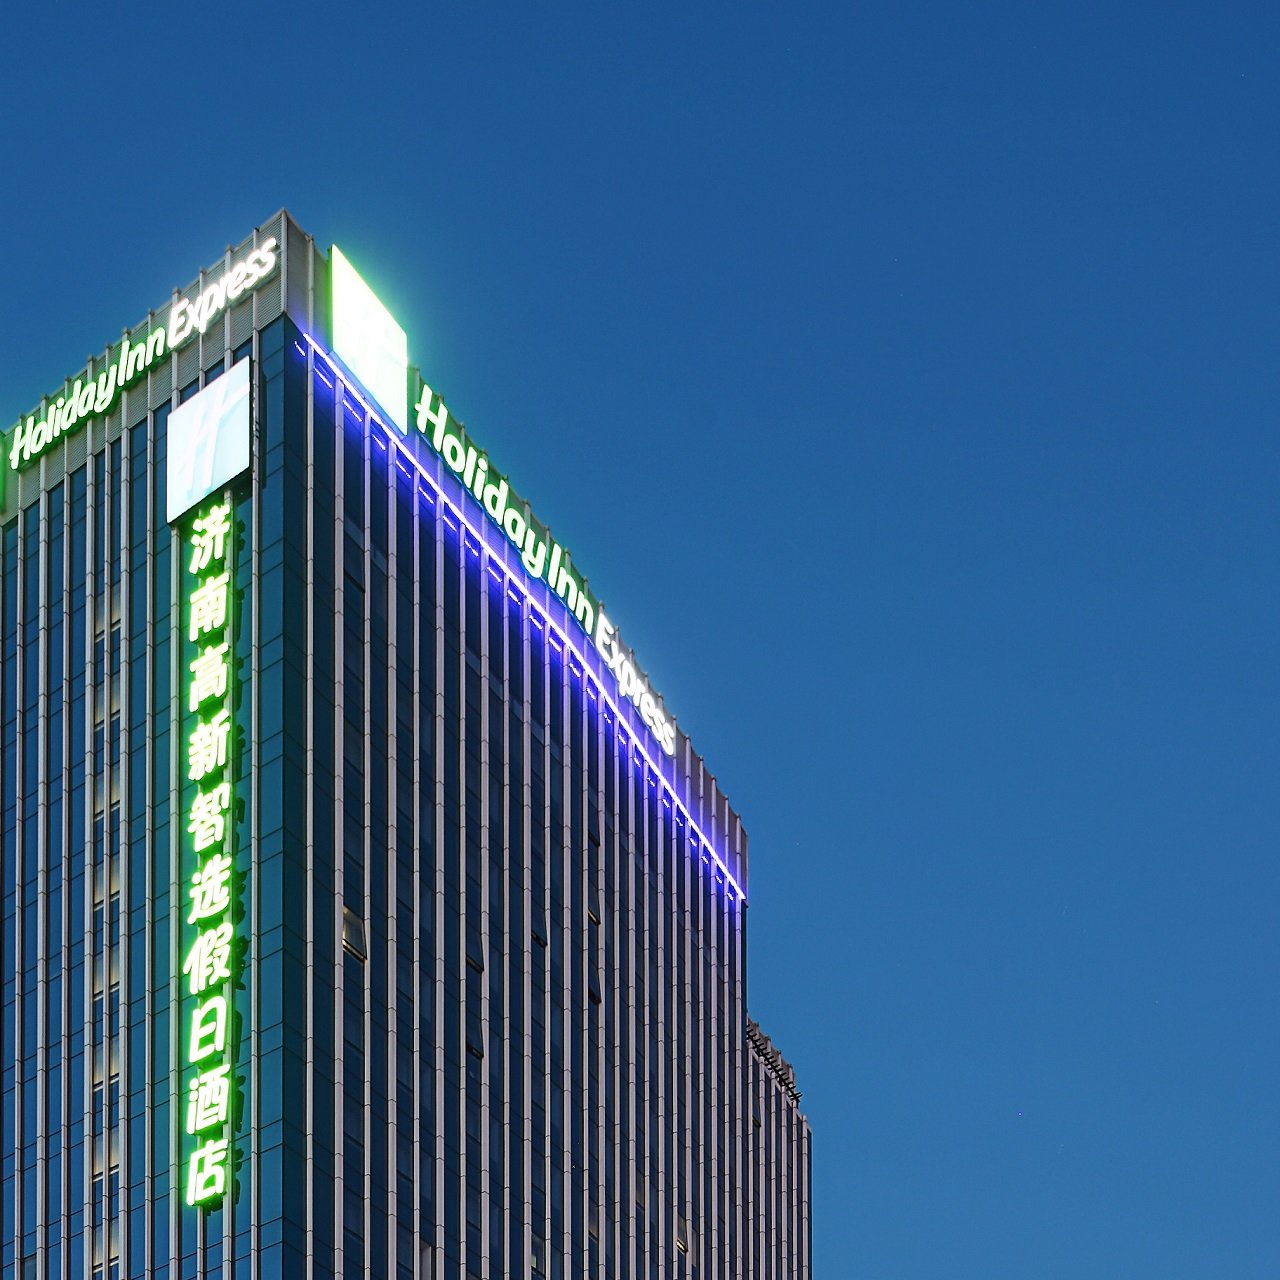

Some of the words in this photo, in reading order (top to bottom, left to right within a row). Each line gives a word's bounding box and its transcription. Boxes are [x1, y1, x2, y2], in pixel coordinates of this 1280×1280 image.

[10, 364, 117, 470] Holiday
[117, 327, 166, 387] Inn
[167, 238, 277, 348] Express
[415, 384, 546, 577] Holiday
[547, 543, 595, 634] Inn
[595, 612, 675, 756] Express
[183, 504, 233, 1206] 济南高新智选假日酒店
